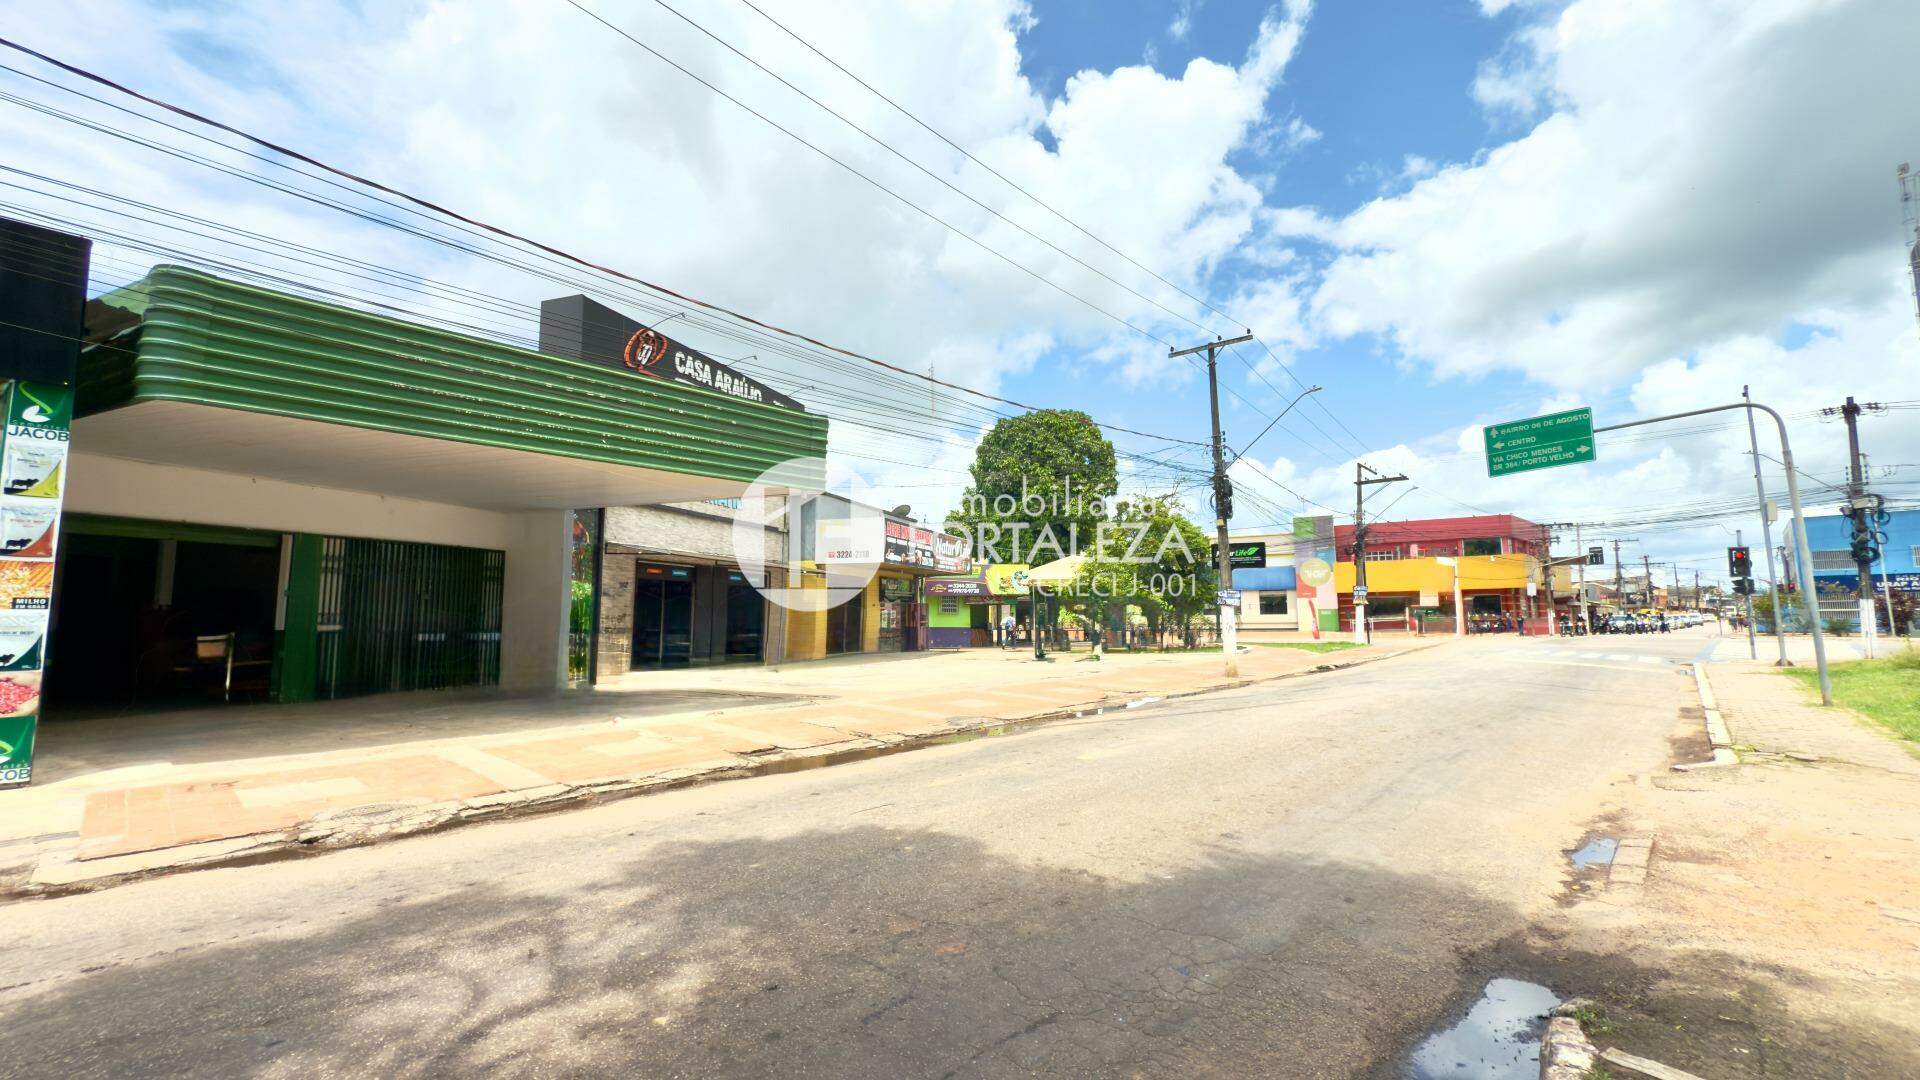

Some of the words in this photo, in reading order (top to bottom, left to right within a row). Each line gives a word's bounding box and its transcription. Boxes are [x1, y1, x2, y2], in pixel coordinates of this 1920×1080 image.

[674, 351, 713, 387] CASA
[714, 370, 763, 402] ARAÚJO
[1500, 424, 1530, 435] BAIRRO
[1556, 413, 1590, 424] AGOSTO
[8, 426, 70, 442] JACOB
[1507, 436, 1537, 447] CENTRO
[1506, 451, 1529, 461] CHICO
[1531, 445, 1563, 456] MENDES
[1522, 456, 1548, 466] PORTO
[1549, 451, 1575, 462] VELHO
